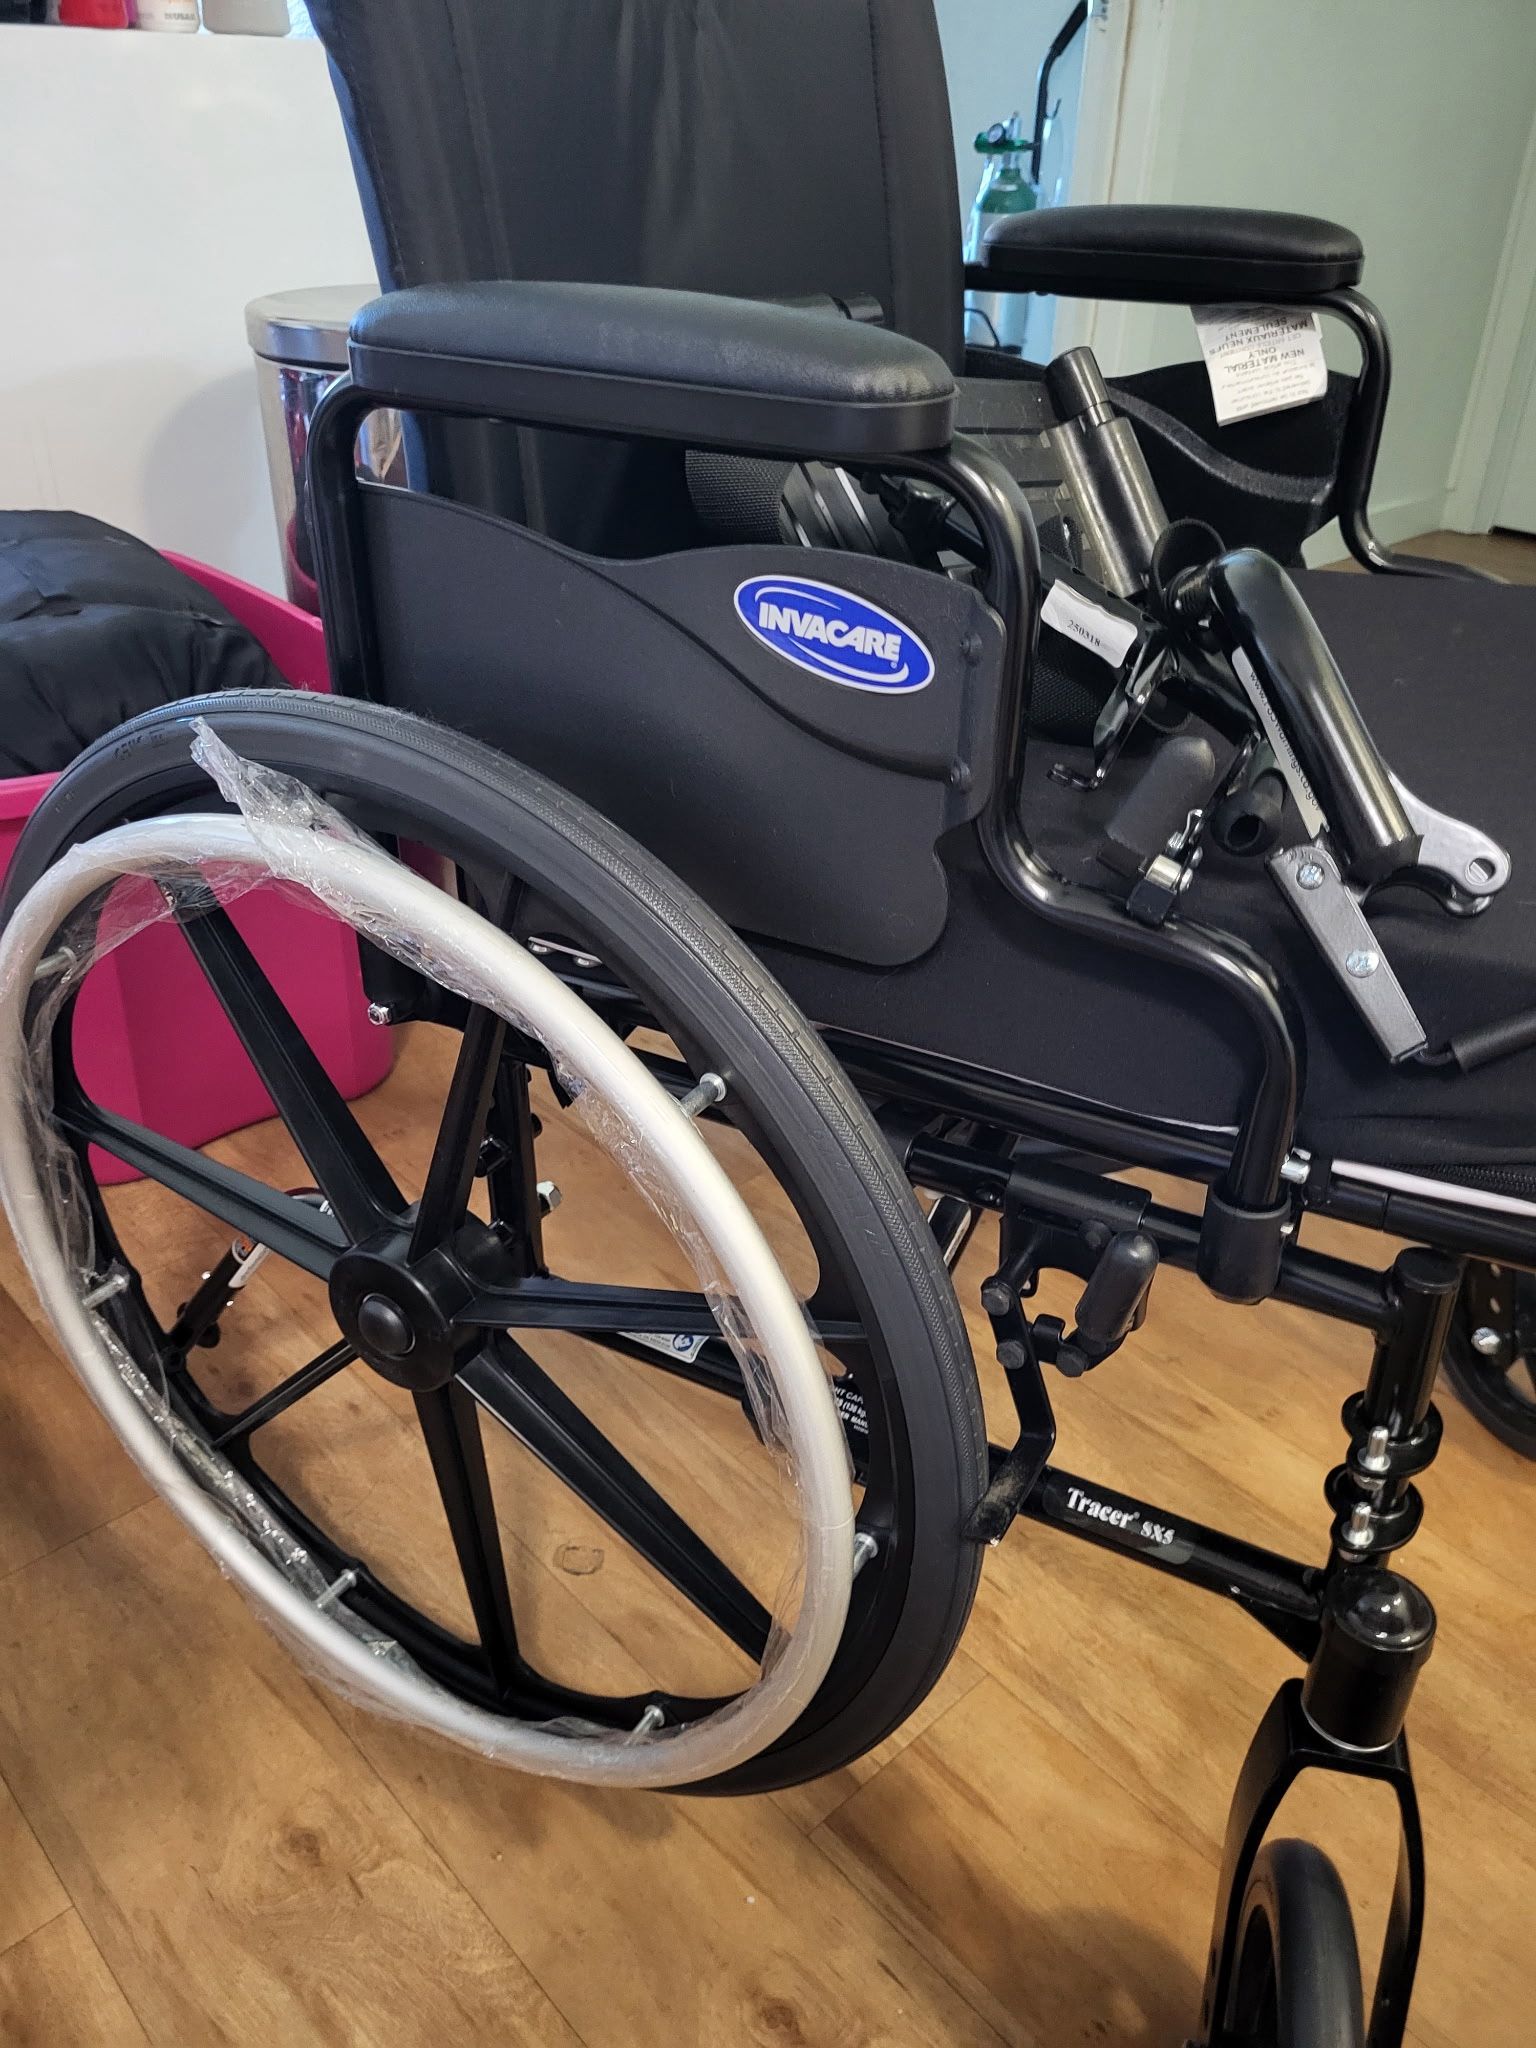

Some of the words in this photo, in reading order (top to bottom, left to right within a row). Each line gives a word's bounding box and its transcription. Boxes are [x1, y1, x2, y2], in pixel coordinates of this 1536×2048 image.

[1225, 316, 1288, 341] SEULEMENT
[1247, 318, 1308, 344] MATERIAUX
[1224, 355, 1279, 374] MATERIAL
[1248, 346, 1277, 359] ONLY
[1280, 348, 1305, 360] NEW
[758, 601, 902, 664] INVACARE
[1066, 619, 1101, 647] 250318
[1066, 1486, 1135, 1529] Tracer
